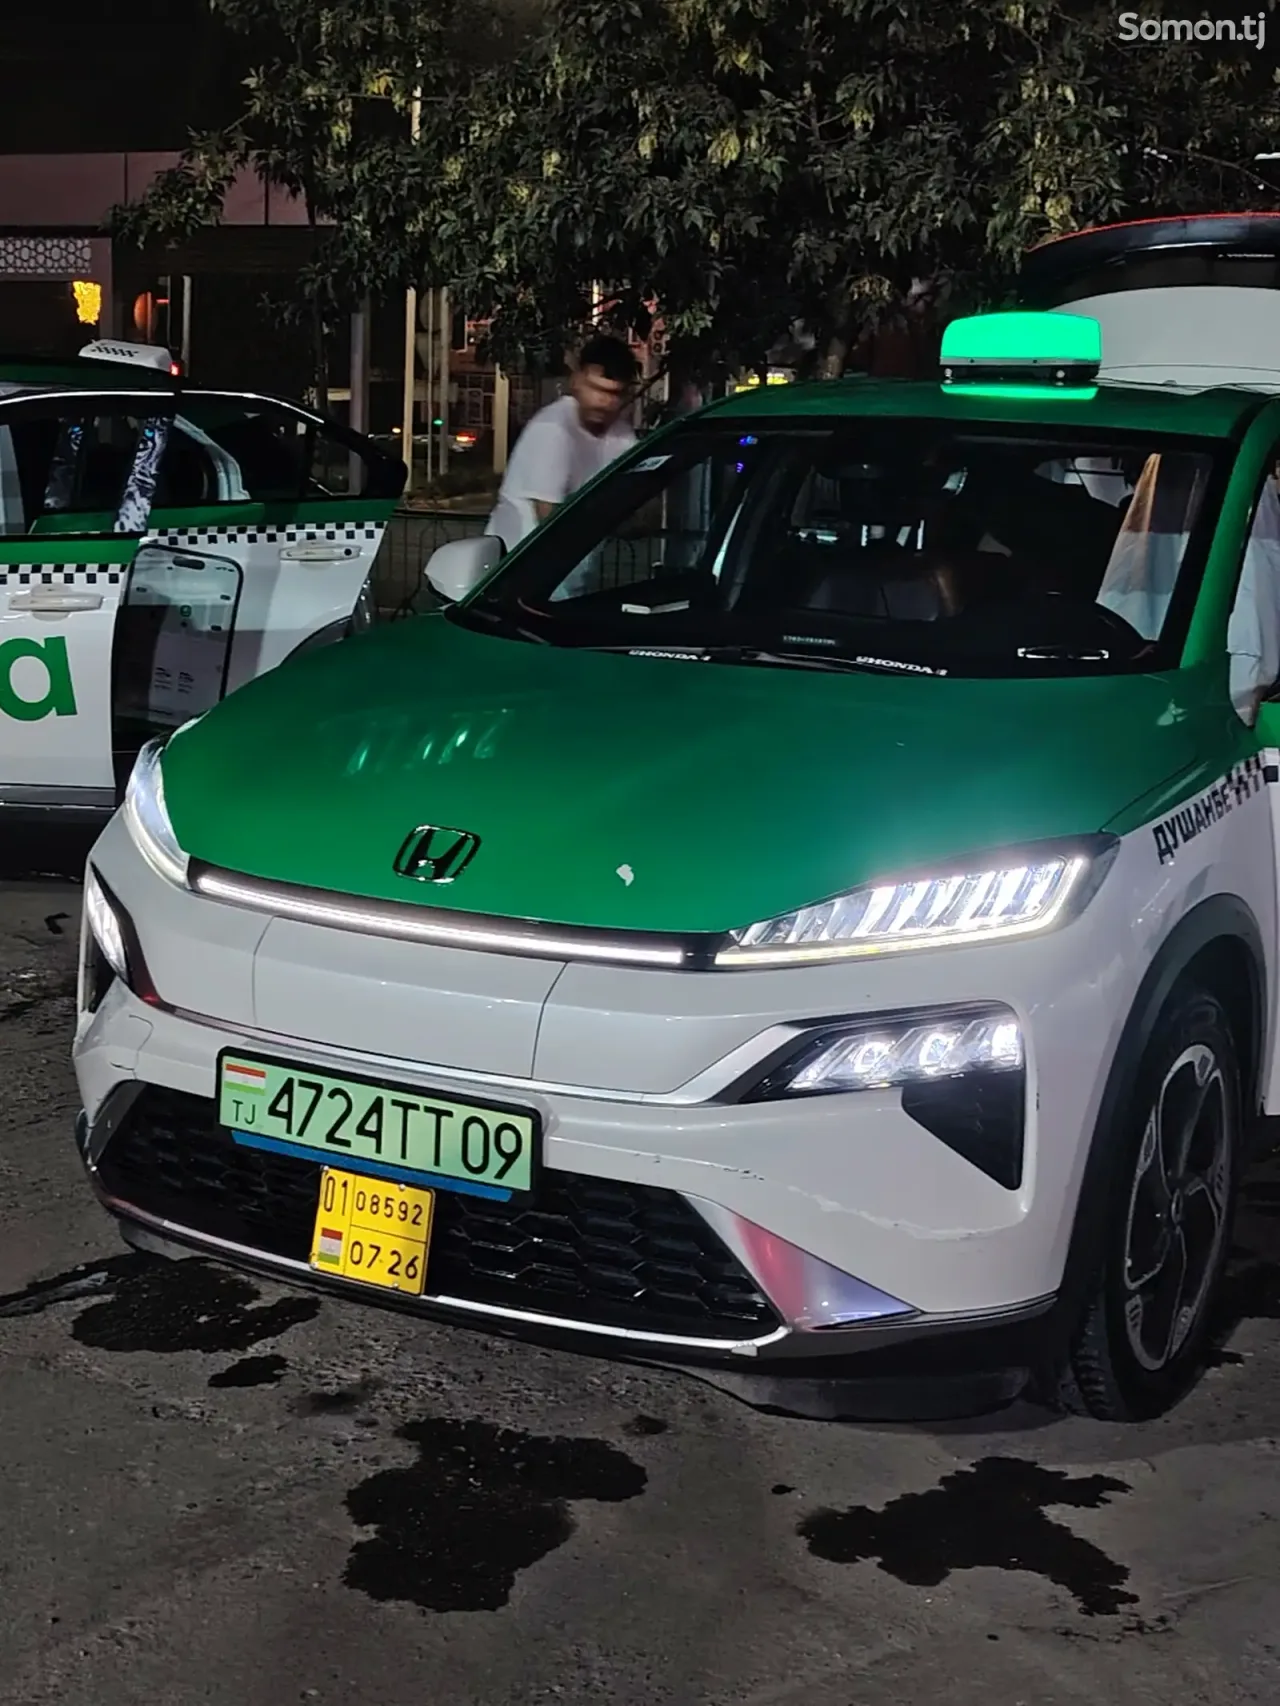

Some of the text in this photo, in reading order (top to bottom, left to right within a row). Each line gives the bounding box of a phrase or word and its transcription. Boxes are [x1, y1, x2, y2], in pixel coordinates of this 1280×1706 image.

[0, 636, 77, 722] a
[1152, 782, 1233, 865] ДУШАНБЕ
[232, 1076, 523, 1180] TJ 4724TT09
[323, 1176, 423, 1226] 01 08592
